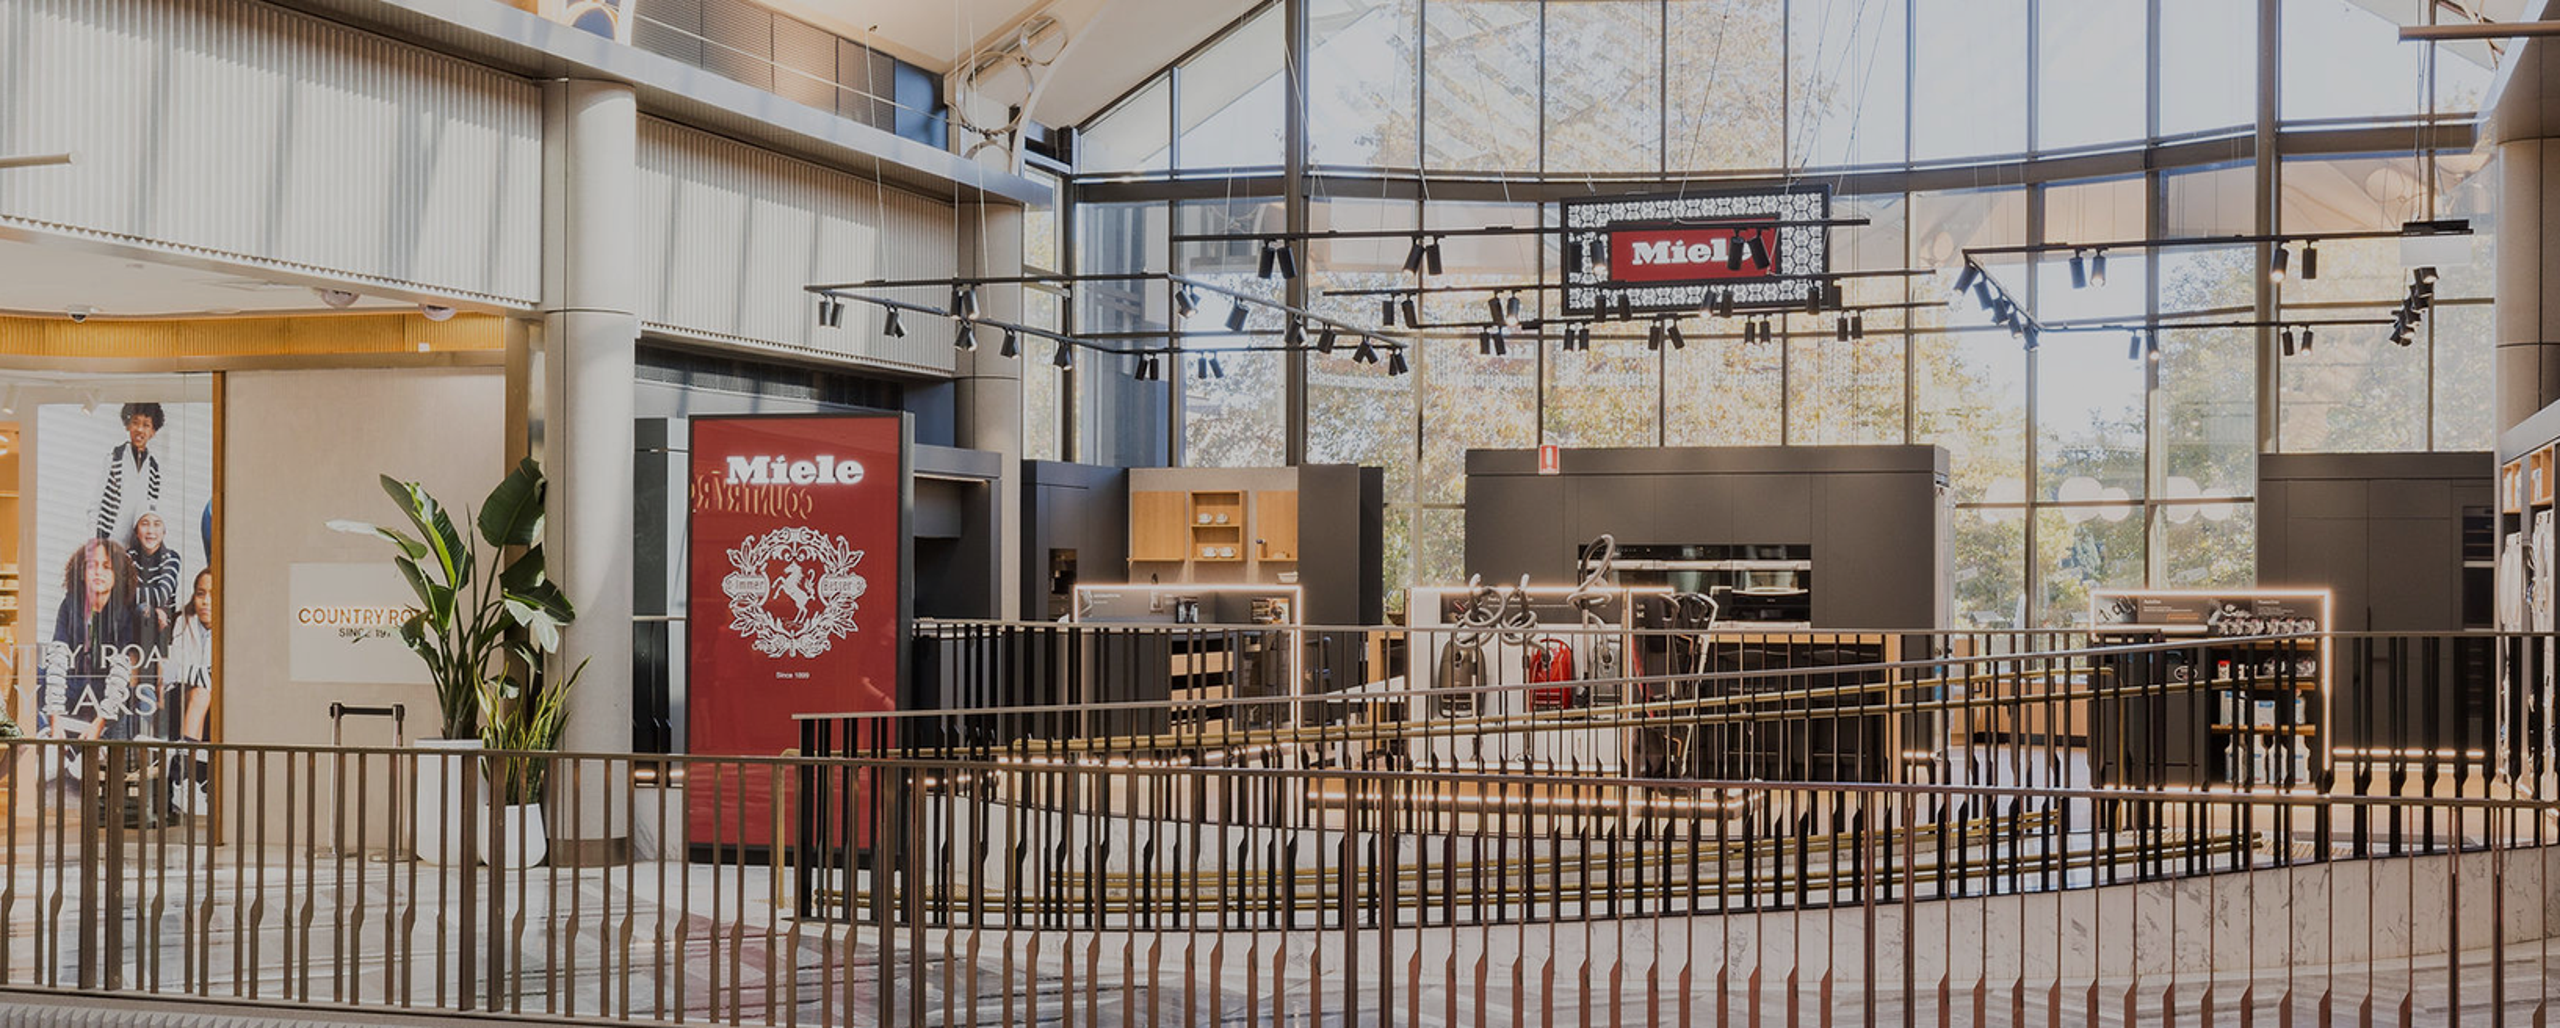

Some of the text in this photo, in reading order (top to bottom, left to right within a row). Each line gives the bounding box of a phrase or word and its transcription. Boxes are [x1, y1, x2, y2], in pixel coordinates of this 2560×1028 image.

[726, 455, 865, 485] Miele
[298, 607, 384, 625] COUNTRY
[100, 643, 173, 670] ROA
